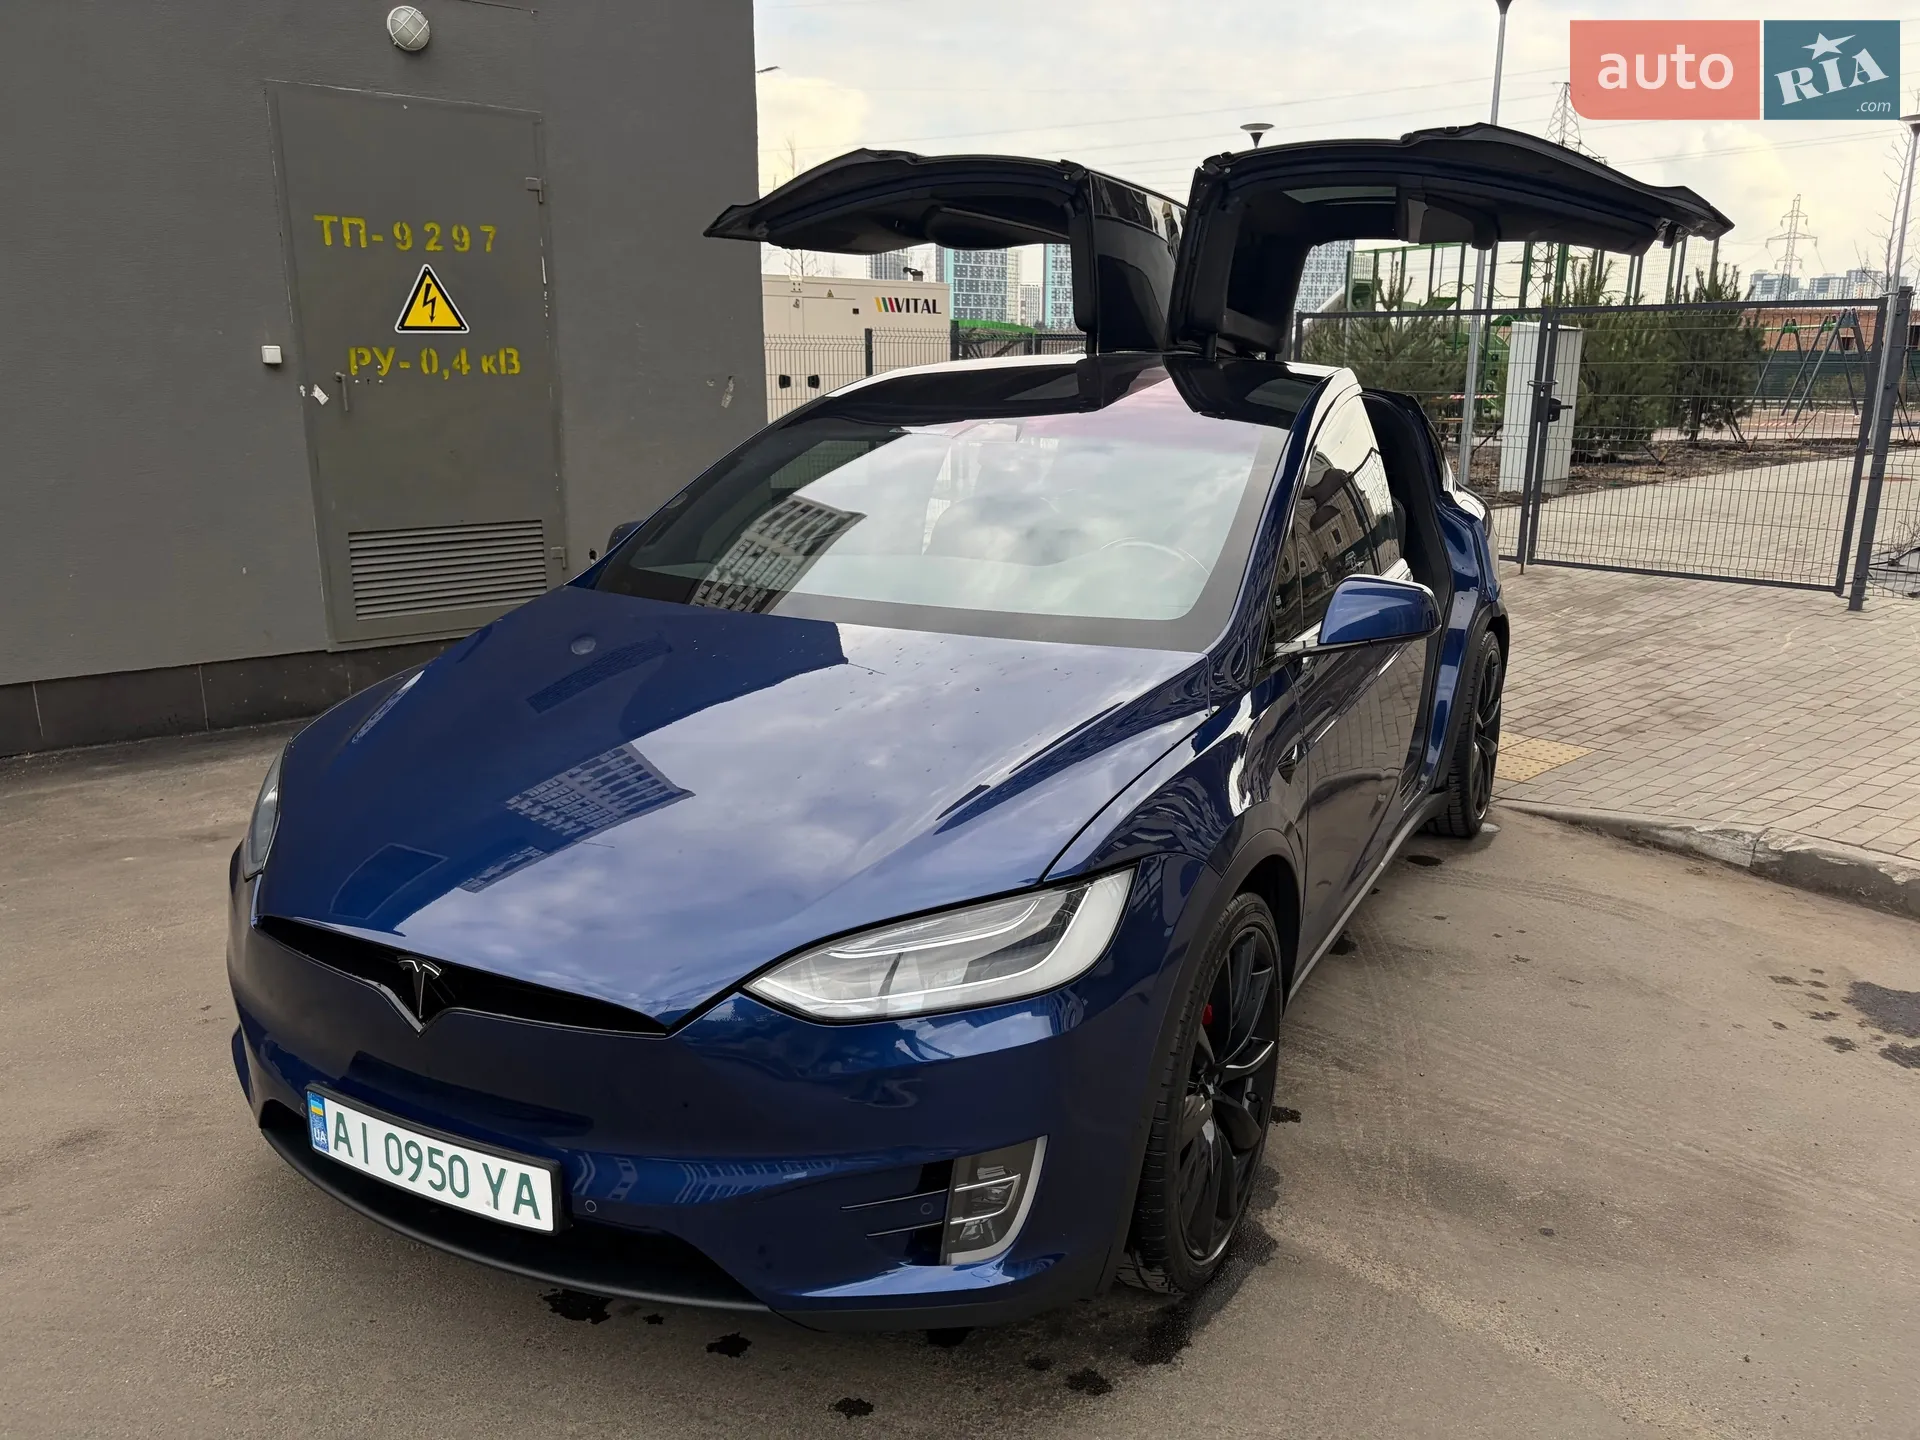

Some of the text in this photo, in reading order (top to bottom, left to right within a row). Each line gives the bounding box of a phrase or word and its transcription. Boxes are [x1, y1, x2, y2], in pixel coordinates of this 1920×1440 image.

[894, 297, 942, 314] VITAL
[384, 1132, 470, 1199] 0950
[481, 1162, 541, 1221] YA
